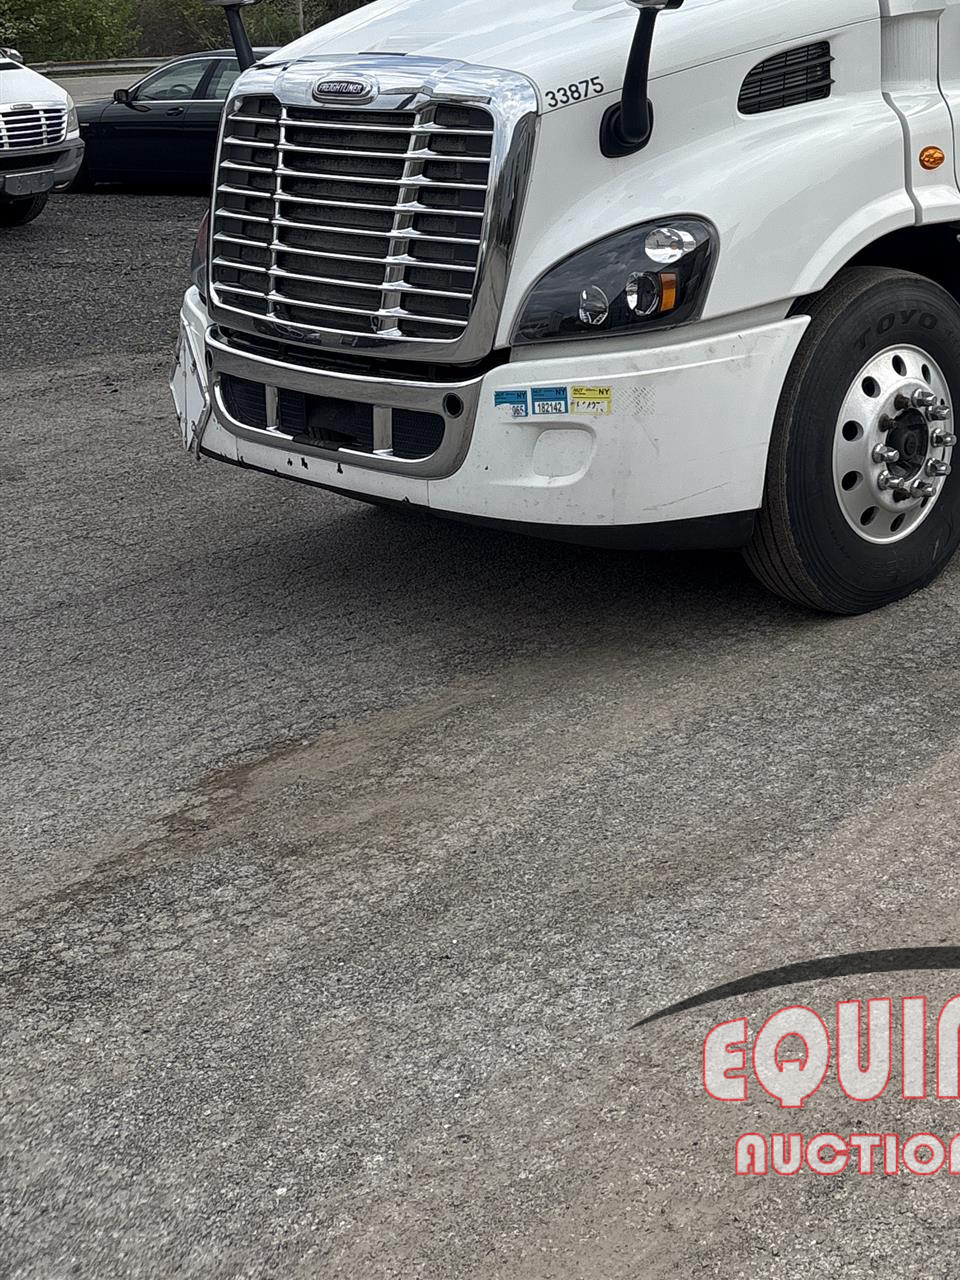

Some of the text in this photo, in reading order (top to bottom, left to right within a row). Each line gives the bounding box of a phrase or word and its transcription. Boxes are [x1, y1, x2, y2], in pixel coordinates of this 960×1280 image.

[318, 81, 363, 94] FREIGHTLINER
[545, 76, 605, 108] 33875
[854, 308, 938, 351] TOYO
[516, 391, 527, 399] NY
[555, 386, 566, 395] NY
[537, 402, 562, 413] 182142
